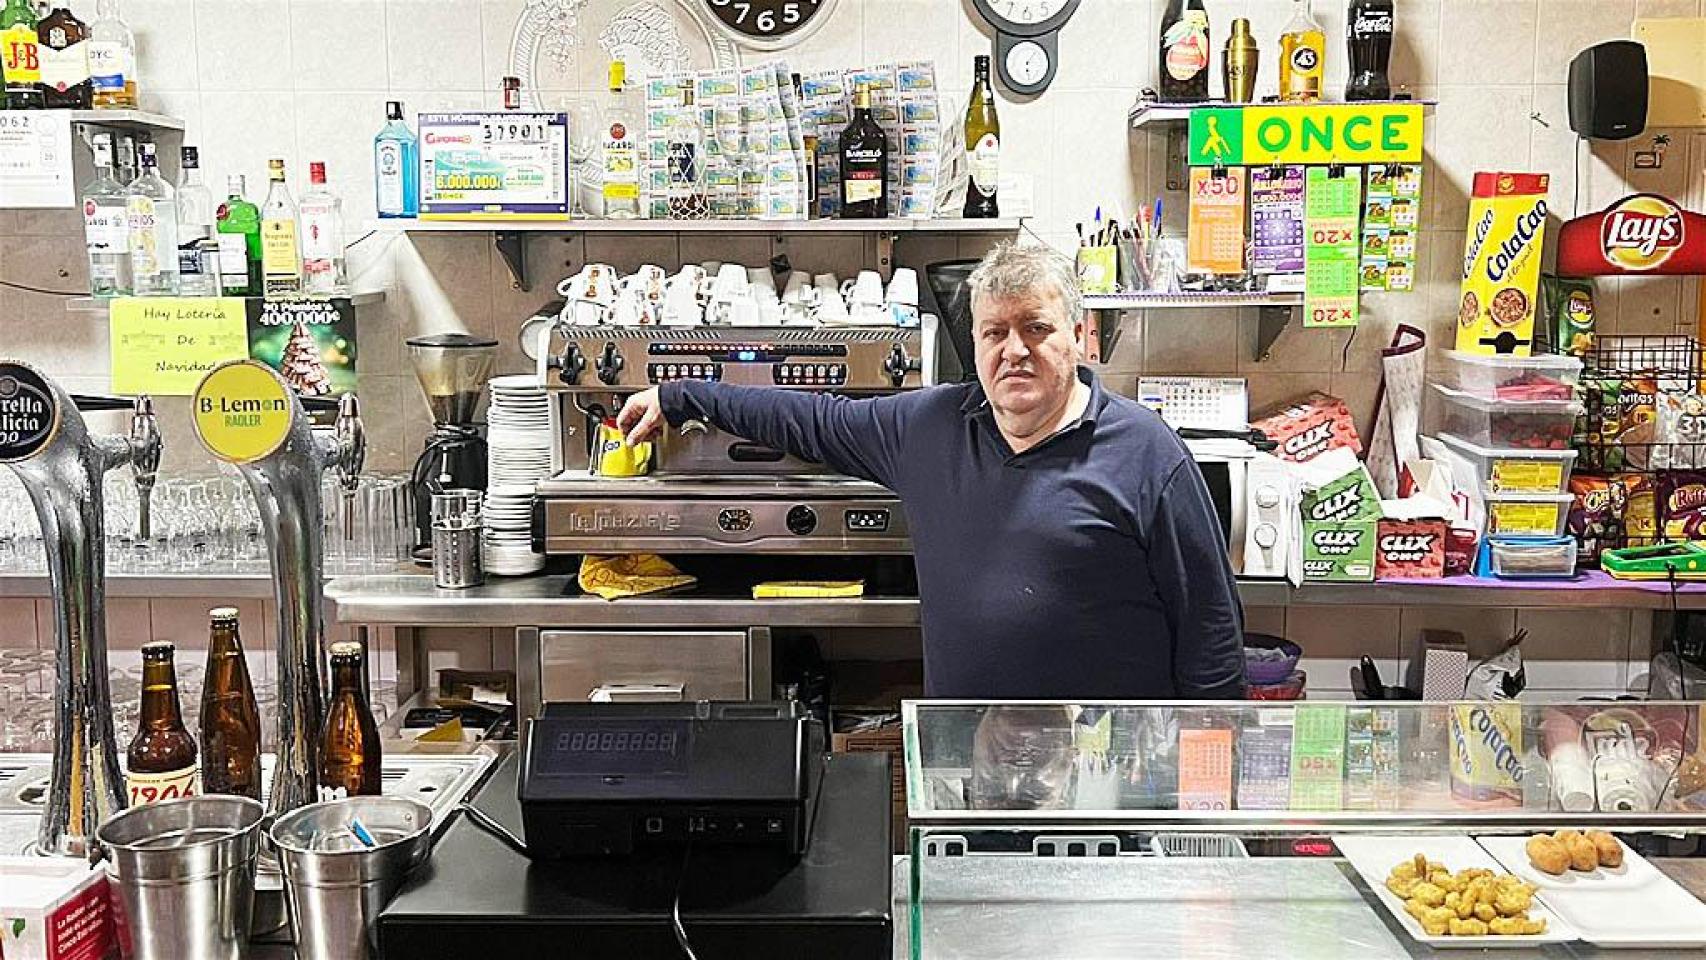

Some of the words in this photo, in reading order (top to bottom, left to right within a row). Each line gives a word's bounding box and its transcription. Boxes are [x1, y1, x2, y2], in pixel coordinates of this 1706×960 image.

[733, 3, 750, 24] 7
[757, 10, 775, 31] 6
[783, 3, 800, 23] 5
[1022, 6, 1032, 20] 6
[1257, 115, 1410, 152] ONCE
[1487, 199, 1547, 282] ColaCao
[1607, 212, 1680, 257] Lay's
[144, 307, 171, 322] Hay
[0, 397, 43, 414] rella
[200, 397, 286, 414] B-Lemon
[0, 413, 39, 431] licia
[224, 414, 261, 428] RADLER
